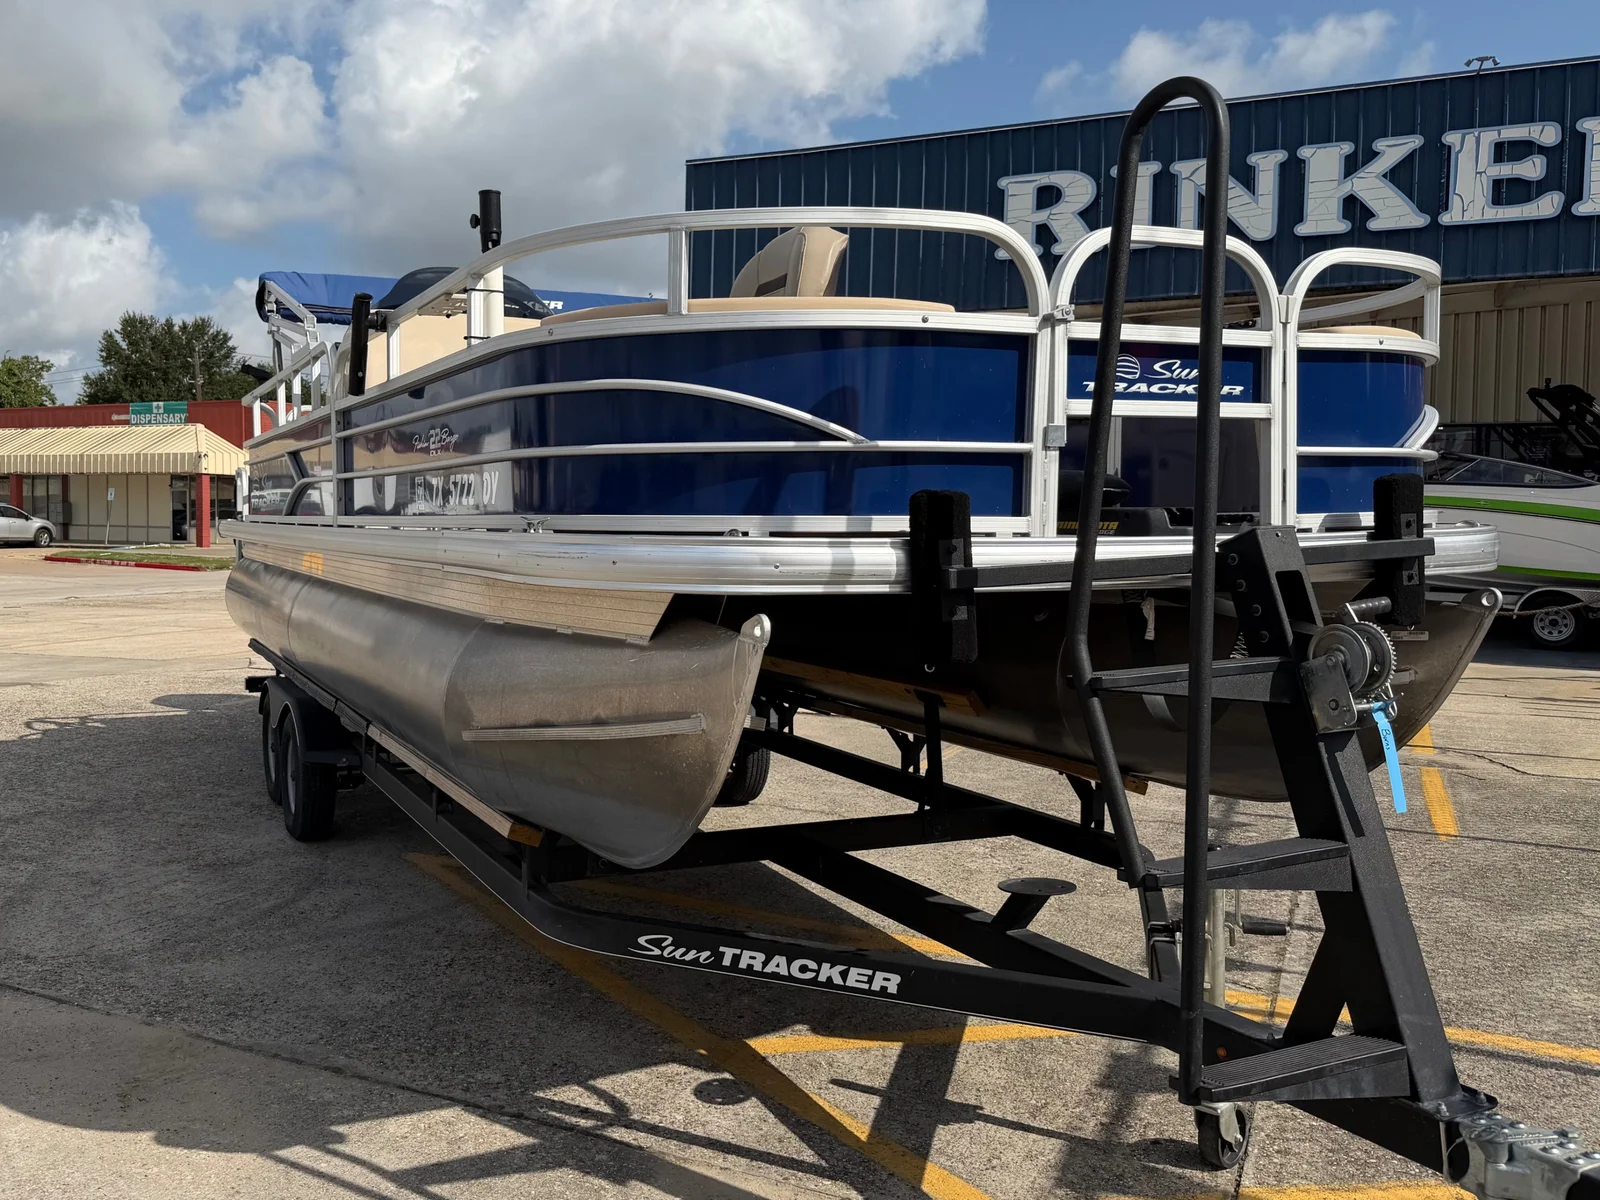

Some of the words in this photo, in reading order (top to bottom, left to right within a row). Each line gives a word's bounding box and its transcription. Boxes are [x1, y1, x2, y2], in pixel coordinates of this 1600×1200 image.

[1144, 359, 1200, 380] Su
[1082, 381, 1245, 396] TRACKR
[131, 413, 187, 424] DISPENSARY
[428, 428, 442, 450] 22
[430, 449, 442, 457] DLX
[432, 476, 444, 506] TX
[449, 473, 475, 506] 5722
[482, 470, 499, 505] DY
[627, 934, 715, 964] Sun
[719, 946, 902, 995] TRACKER
